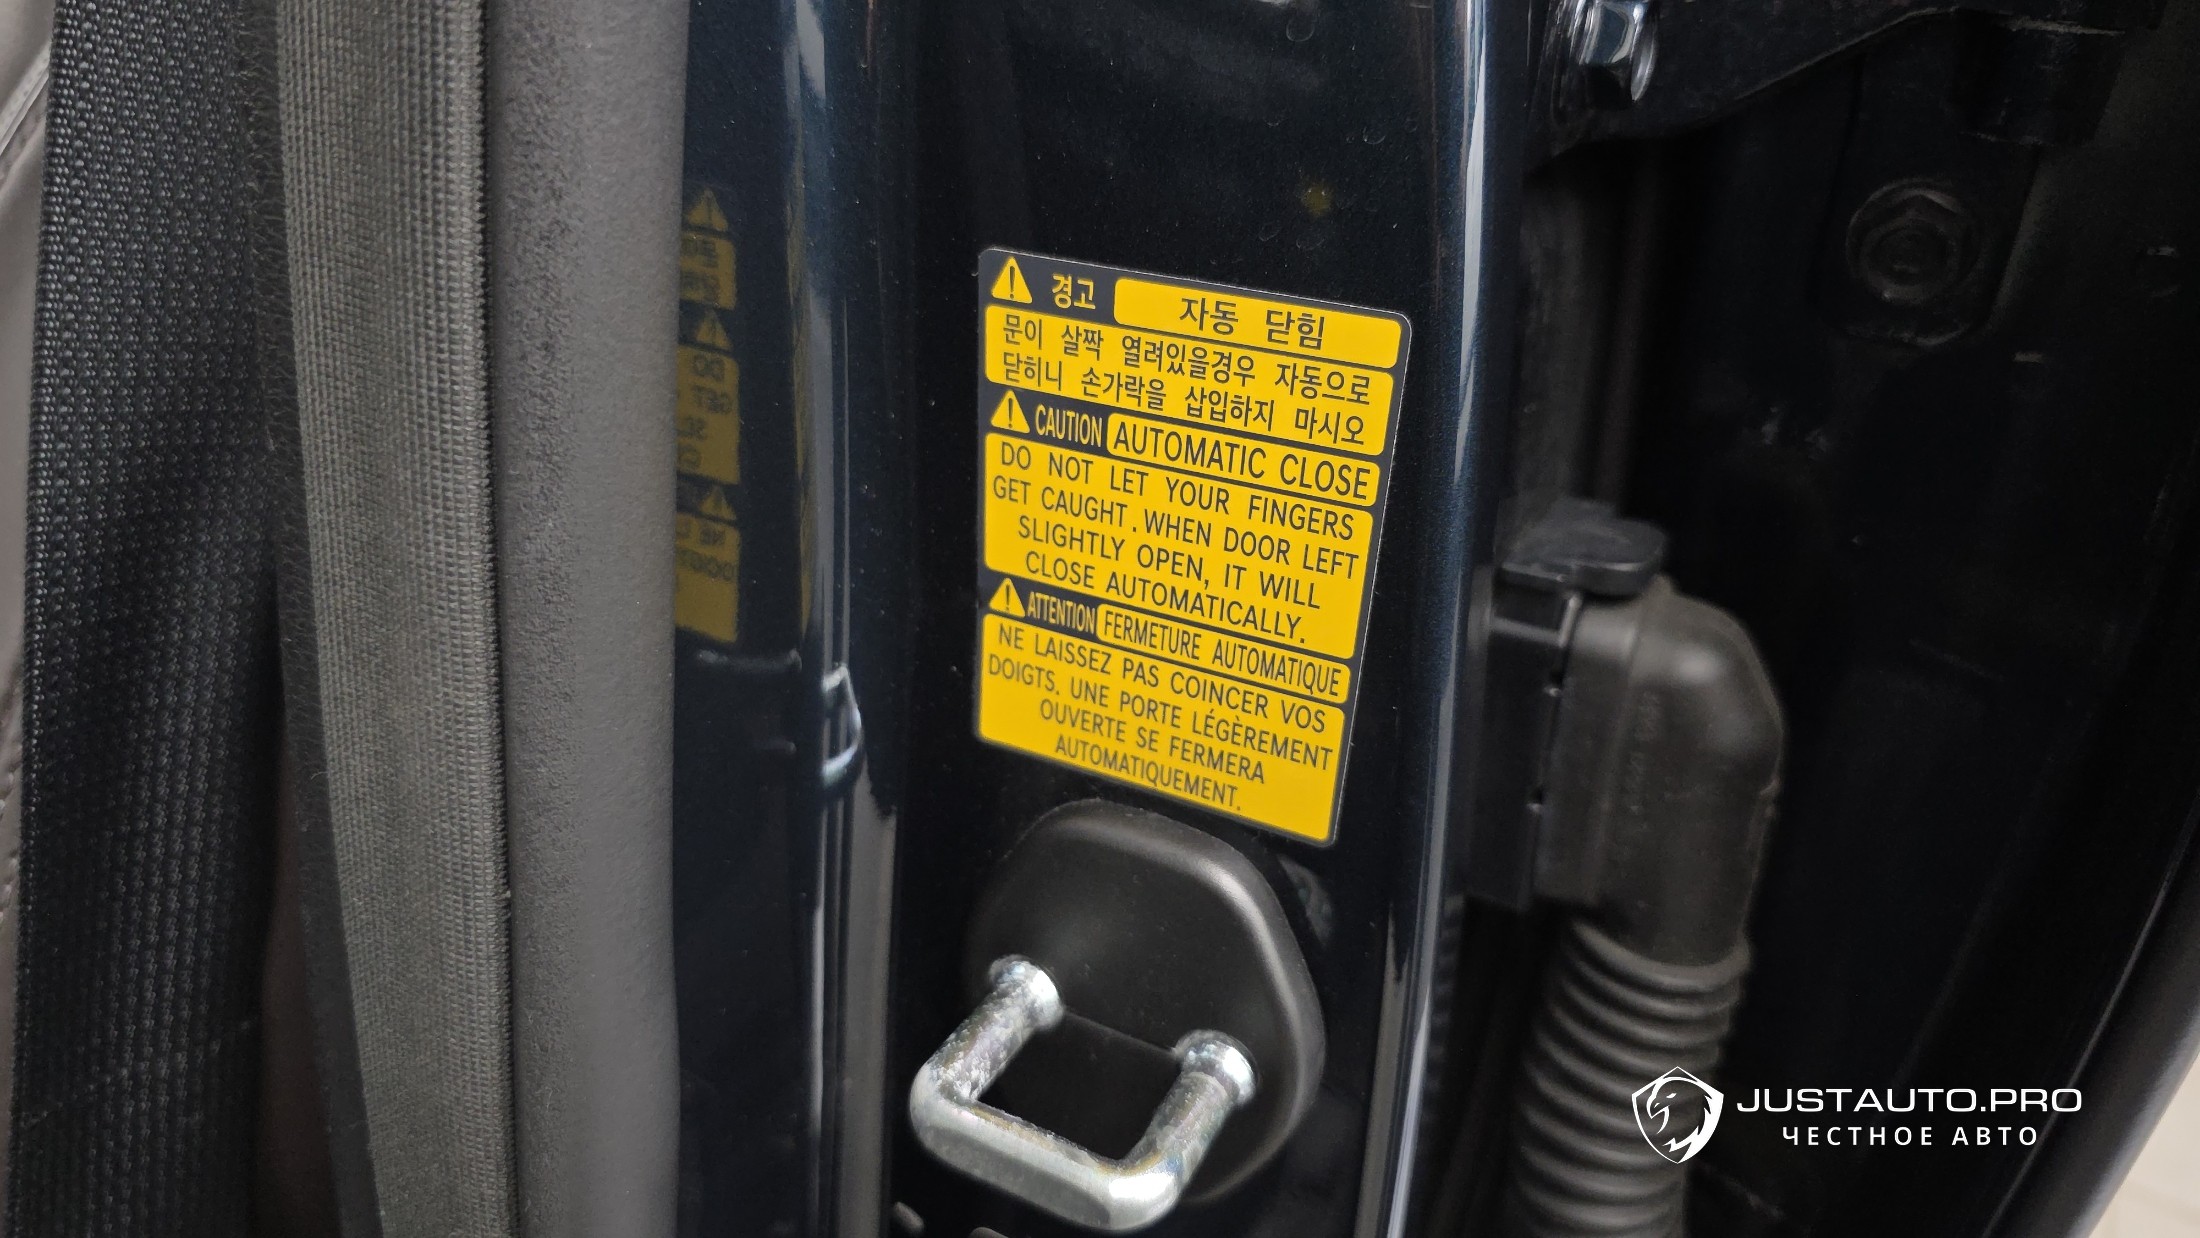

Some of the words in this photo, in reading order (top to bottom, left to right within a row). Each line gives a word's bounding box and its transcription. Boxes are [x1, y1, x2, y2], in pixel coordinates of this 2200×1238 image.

[1003, 313, 1043, 350] 문이
[1061, 324, 1104, 361] 살짝
[1121, 335, 1256, 388] 열려있을경우
[1274, 362, 1370, 405] 자동으로
[1052, 273, 1096, 310] 경고
[1179, 297, 1239, 336] 자동
[1265, 309, 1325, 351] 닫힘
[1003, 351, 1063, 391] 닫히니
[1081, 366, 1167, 411] 손가락을
[1184, 385, 1275, 432] 삽입하지
[1294, 406, 1365, 446] 마시오
[1001, 441, 1032, 470] DO
[1048, 452, 1094, 484] NOT
[1110, 465, 1149, 496] LET
[1165, 476, 1230, 515] YOUR
[1248, 494, 1355, 541] FINGERS
[1034, 403, 1103, 447] CAUTION
[1113, 421, 1267, 479] AUTOMATIC
[1279, 453, 1371, 500] CLOSE
[993, 475, 1032, 505] GET
[1223, 526, 1291, 565] DOOR
[1302, 543, 1360, 580] LEFT
[1018, 515, 1126, 561] SLIGHTLY
[1137, 543, 1210, 590] OPEN,
[1224, 563, 1248, 590] IT
[1259, 570, 1321, 609] WILL
[1026, 550, 1096, 590] CLOSE
[1105, 571, 1306, 644] AUTOMATICALLY.
[1026, 591, 1096, 635] ATTENTION
[1103, 609, 1202, 661] FERMETURE
[1211, 638, 1342, 697] AUTOMATIQUE
[999, 622, 1025, 650] NE
[1035, 632, 1112, 675] LAISSEZ
[1122, 657, 1159, 688] PAS
[1170, 670, 1269, 719] COINCER
[1281, 699, 1326, 734] VOS
[1070, 676, 1111, 707] UNE
[1119, 690, 1182, 729] PORTE
[1191, 708, 1333, 771] LÉGÈREMENT
[1039, 698, 1127, 743] OUVERTE
[1136, 725, 1160, 752] SE
[1169, 735, 1265, 785] FERMERA
[1055, 733, 1242, 811] AUTOMATIQUEMENT.
